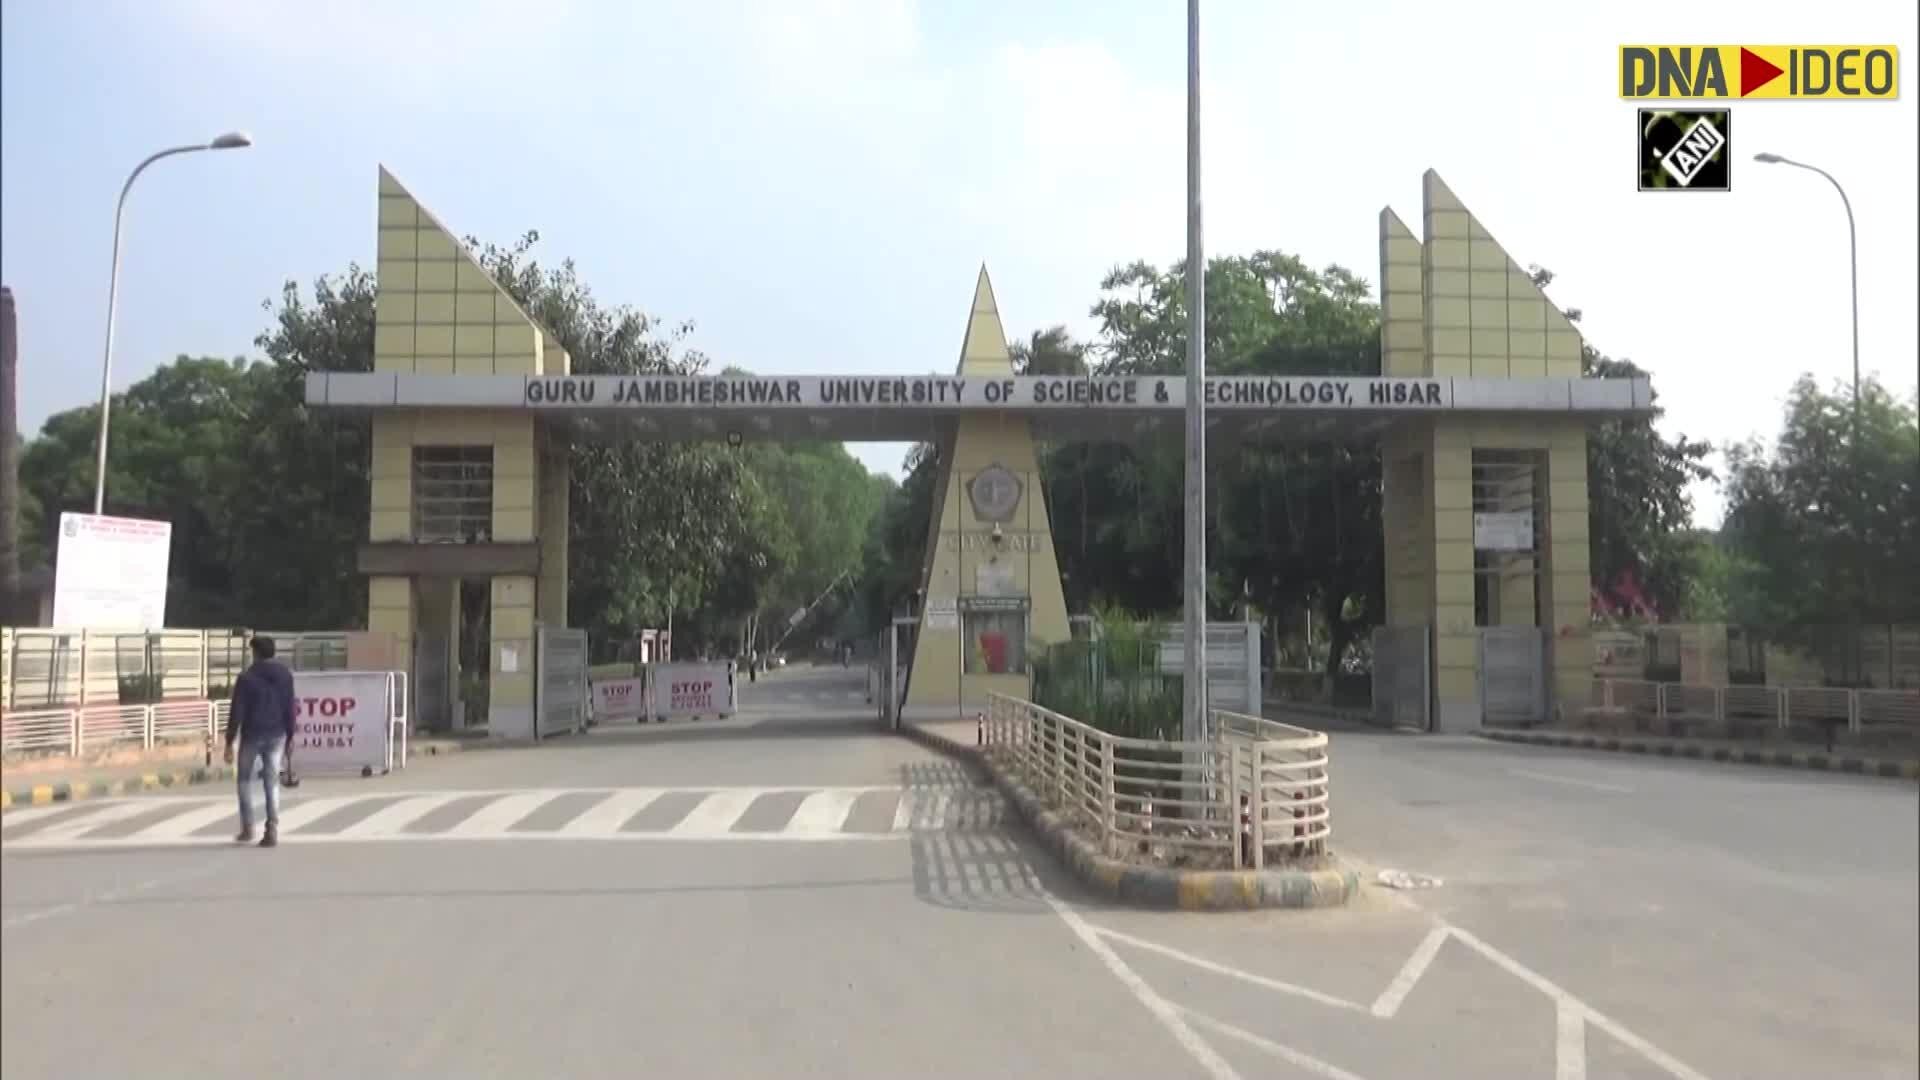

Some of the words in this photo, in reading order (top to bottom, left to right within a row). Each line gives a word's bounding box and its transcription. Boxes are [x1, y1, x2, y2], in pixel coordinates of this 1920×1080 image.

[526, 379, 596, 402] GURU
[612, 379, 802, 404] JAMBHESHWAR
[819, 379, 967, 404] UNIVERSITY
[983, 379, 1016, 403] OF
[1033, 379, 1138, 403] SCIENCE
[1153, 380, 1169, 403] &
[1204, 381, 1354, 406] ECHNOLOGY,
[1369, 381, 1442, 404] HISAR
[601, 684, 633, 697] STOP
[671, 680, 713, 694] STOP
[295, 722, 354, 735] ECURITY
